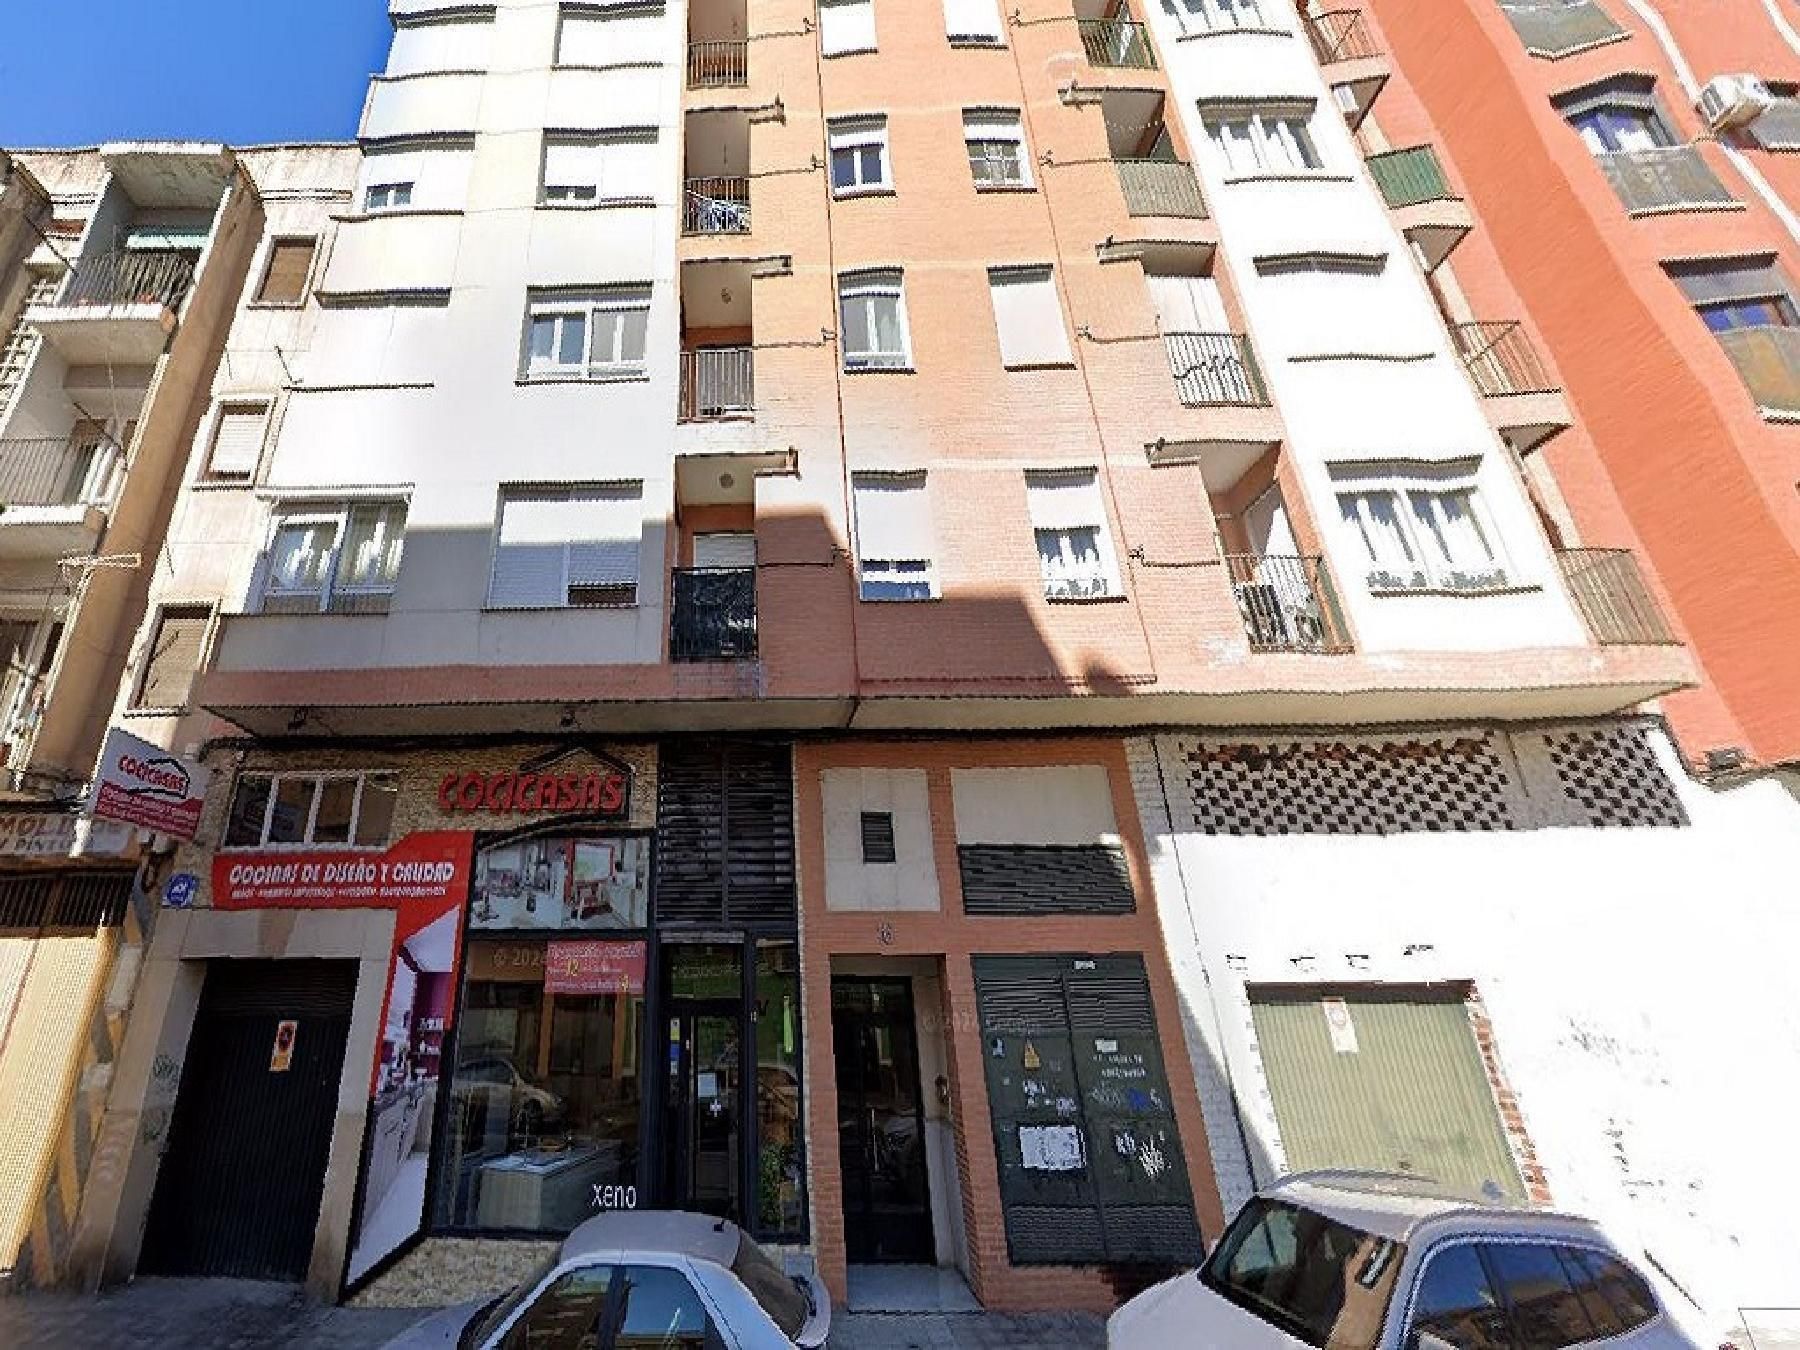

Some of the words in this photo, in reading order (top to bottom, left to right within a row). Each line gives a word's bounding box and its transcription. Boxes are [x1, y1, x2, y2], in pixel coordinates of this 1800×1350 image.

[438, 770, 624, 813] COCICASAS
[229, 862, 300, 885] COCINAS
[301, 862, 321, 883] DE
[323, 857, 377, 883] DISEÑO
[380, 862, 389, 882] Y
[391, 861, 455, 883] CALIDAD
